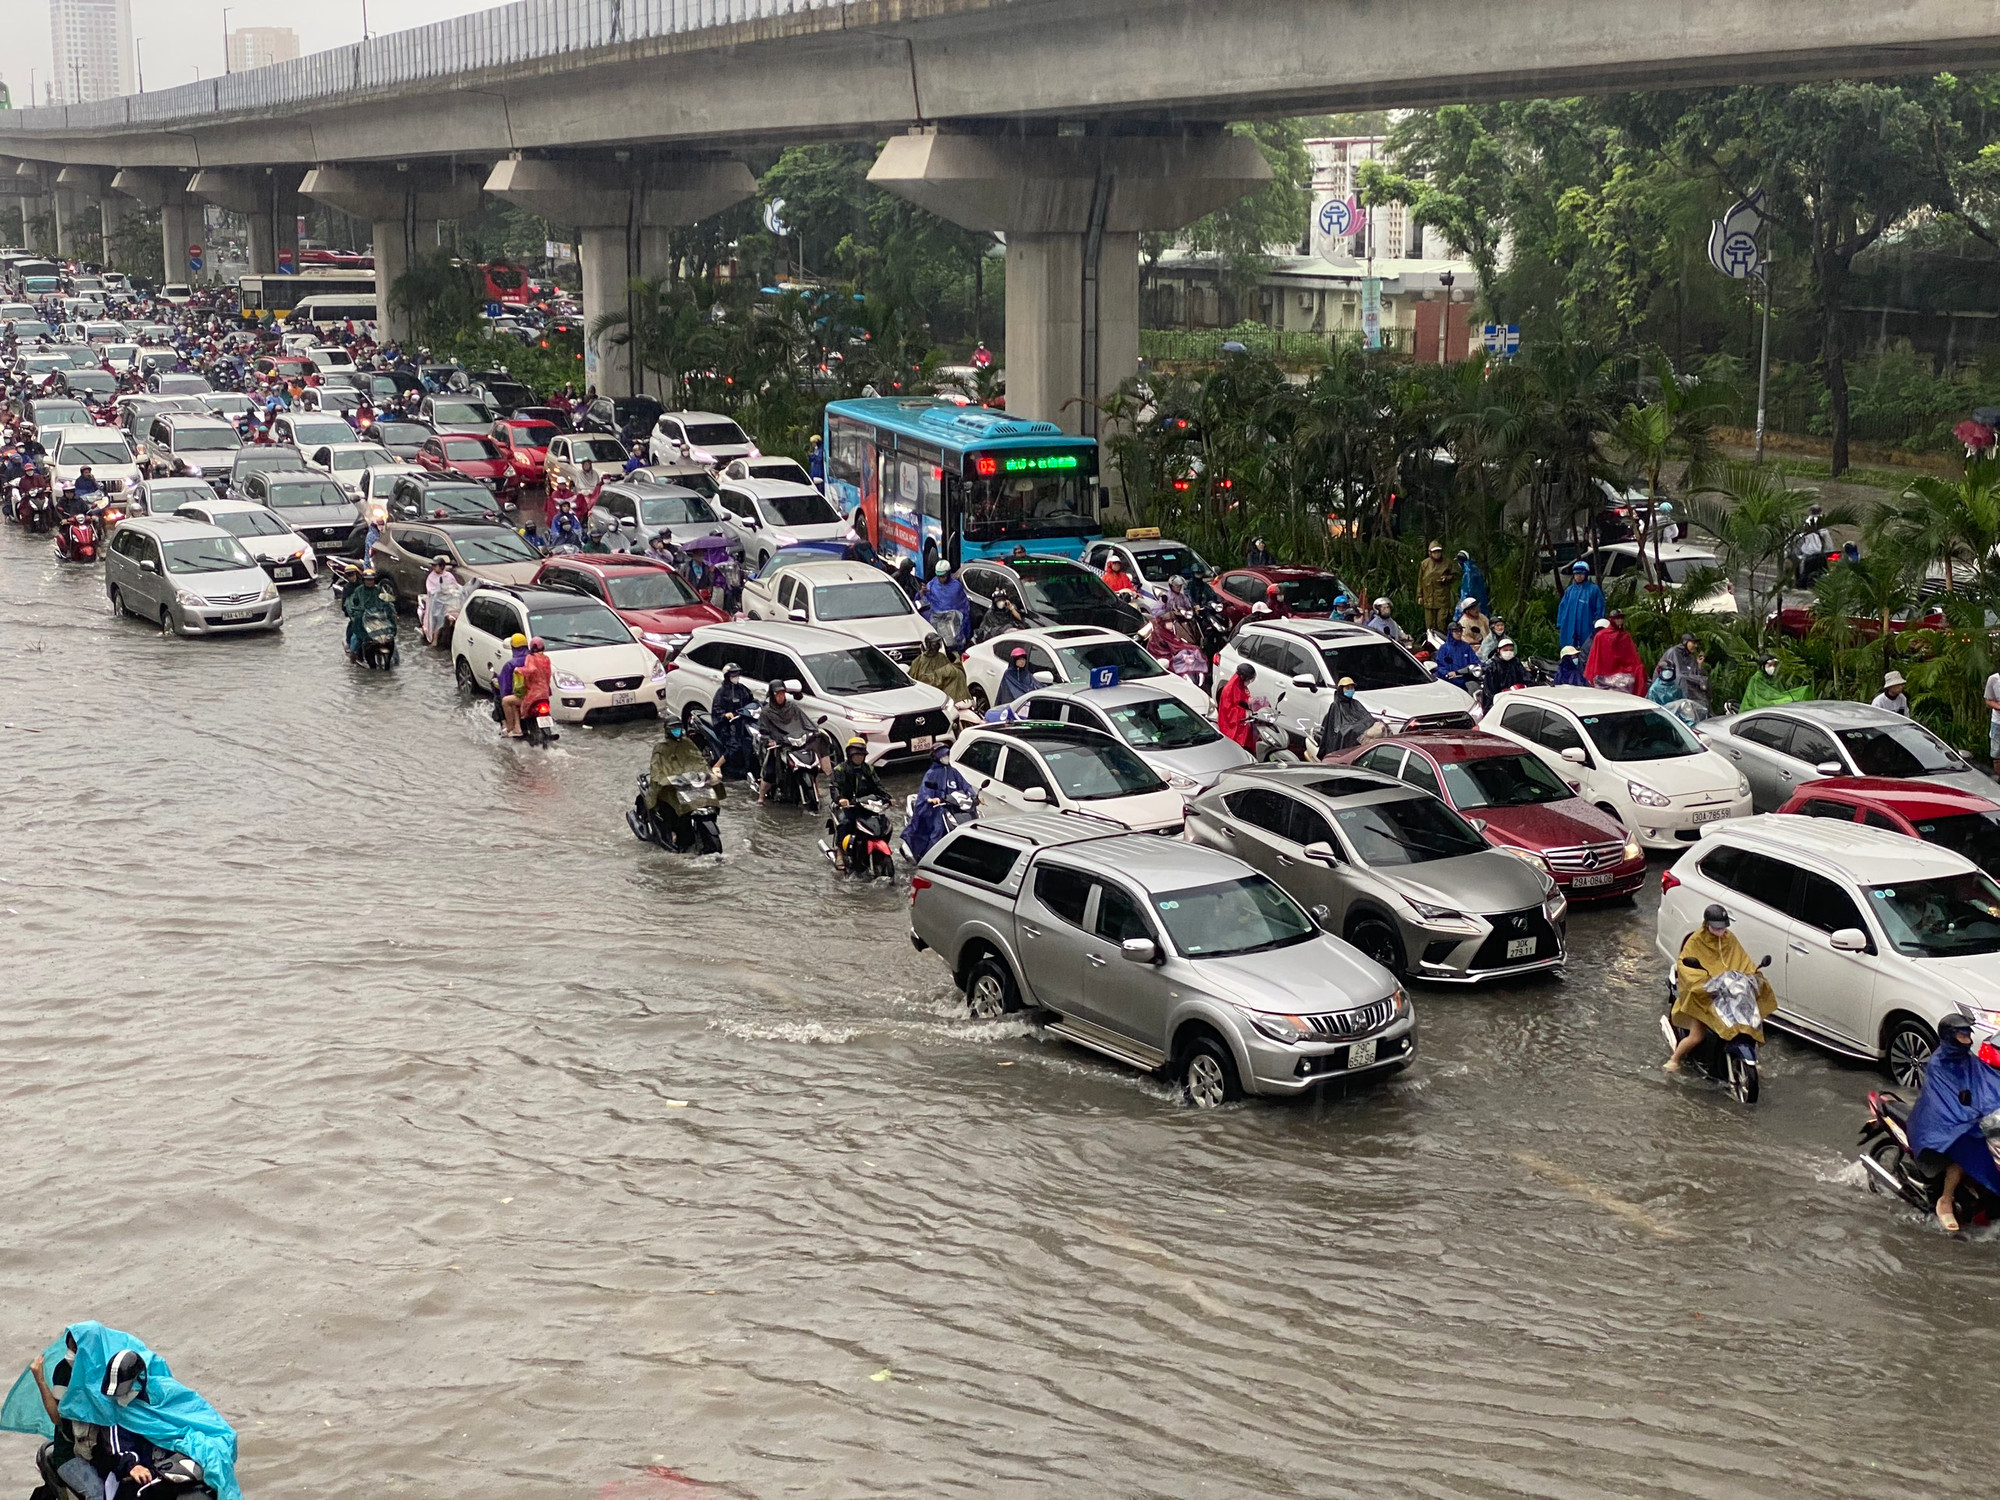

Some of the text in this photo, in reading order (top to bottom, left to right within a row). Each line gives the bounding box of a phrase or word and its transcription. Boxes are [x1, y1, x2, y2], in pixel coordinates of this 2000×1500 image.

[979, 459, 996, 473] 02
[1100, 669, 1113, 685] G7
[1516, 940, 1529, 948] 30K
[1356, 1042, 1371, 1054] 29C
